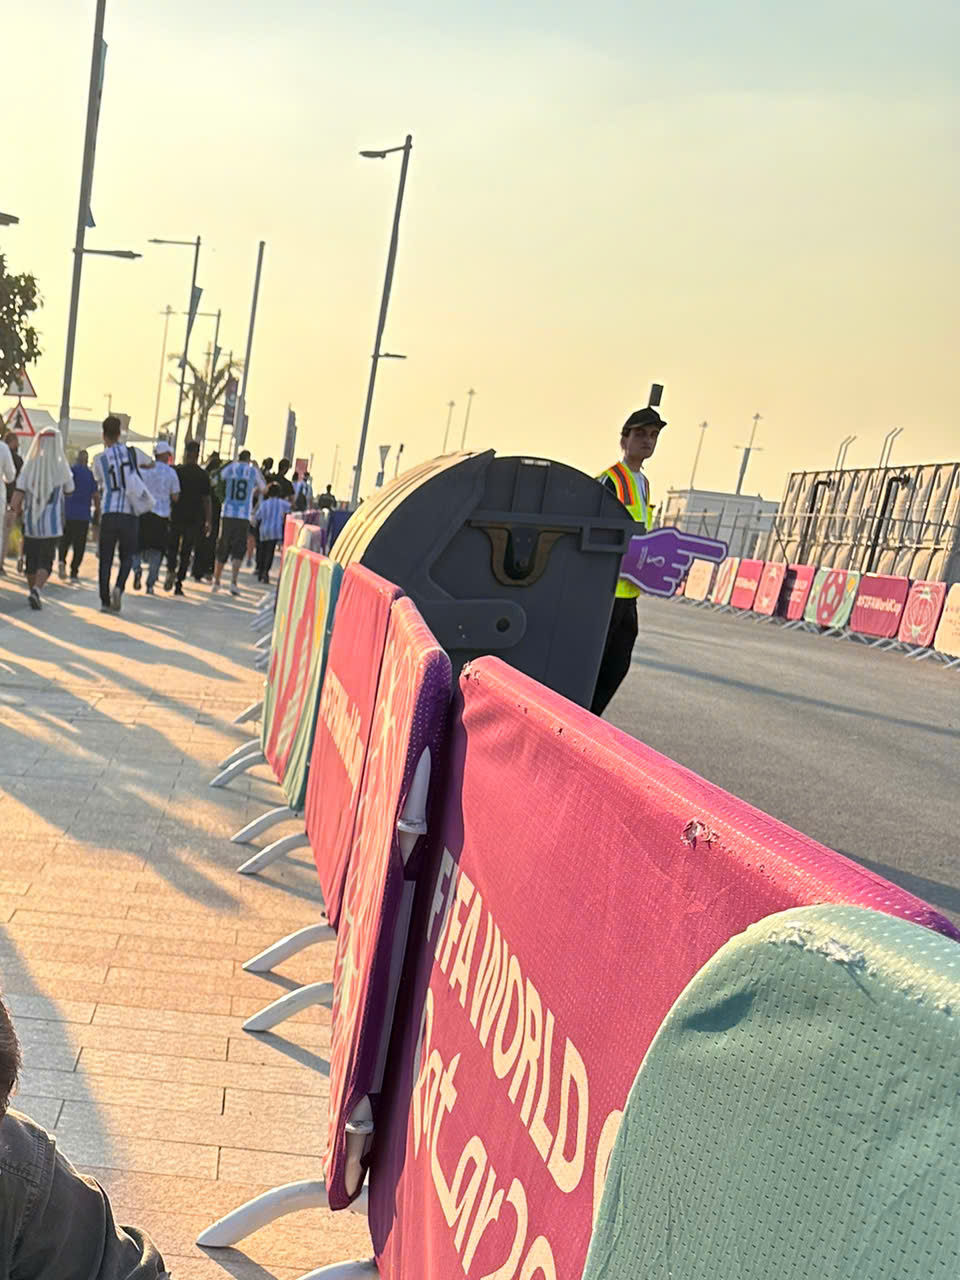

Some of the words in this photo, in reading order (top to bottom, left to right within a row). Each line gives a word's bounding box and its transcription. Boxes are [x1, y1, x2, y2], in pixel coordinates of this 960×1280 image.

[230, 478, 248, 502] 18
[426, 846, 483, 1009] FIFA
[470, 911, 589, 1194] WORLD
